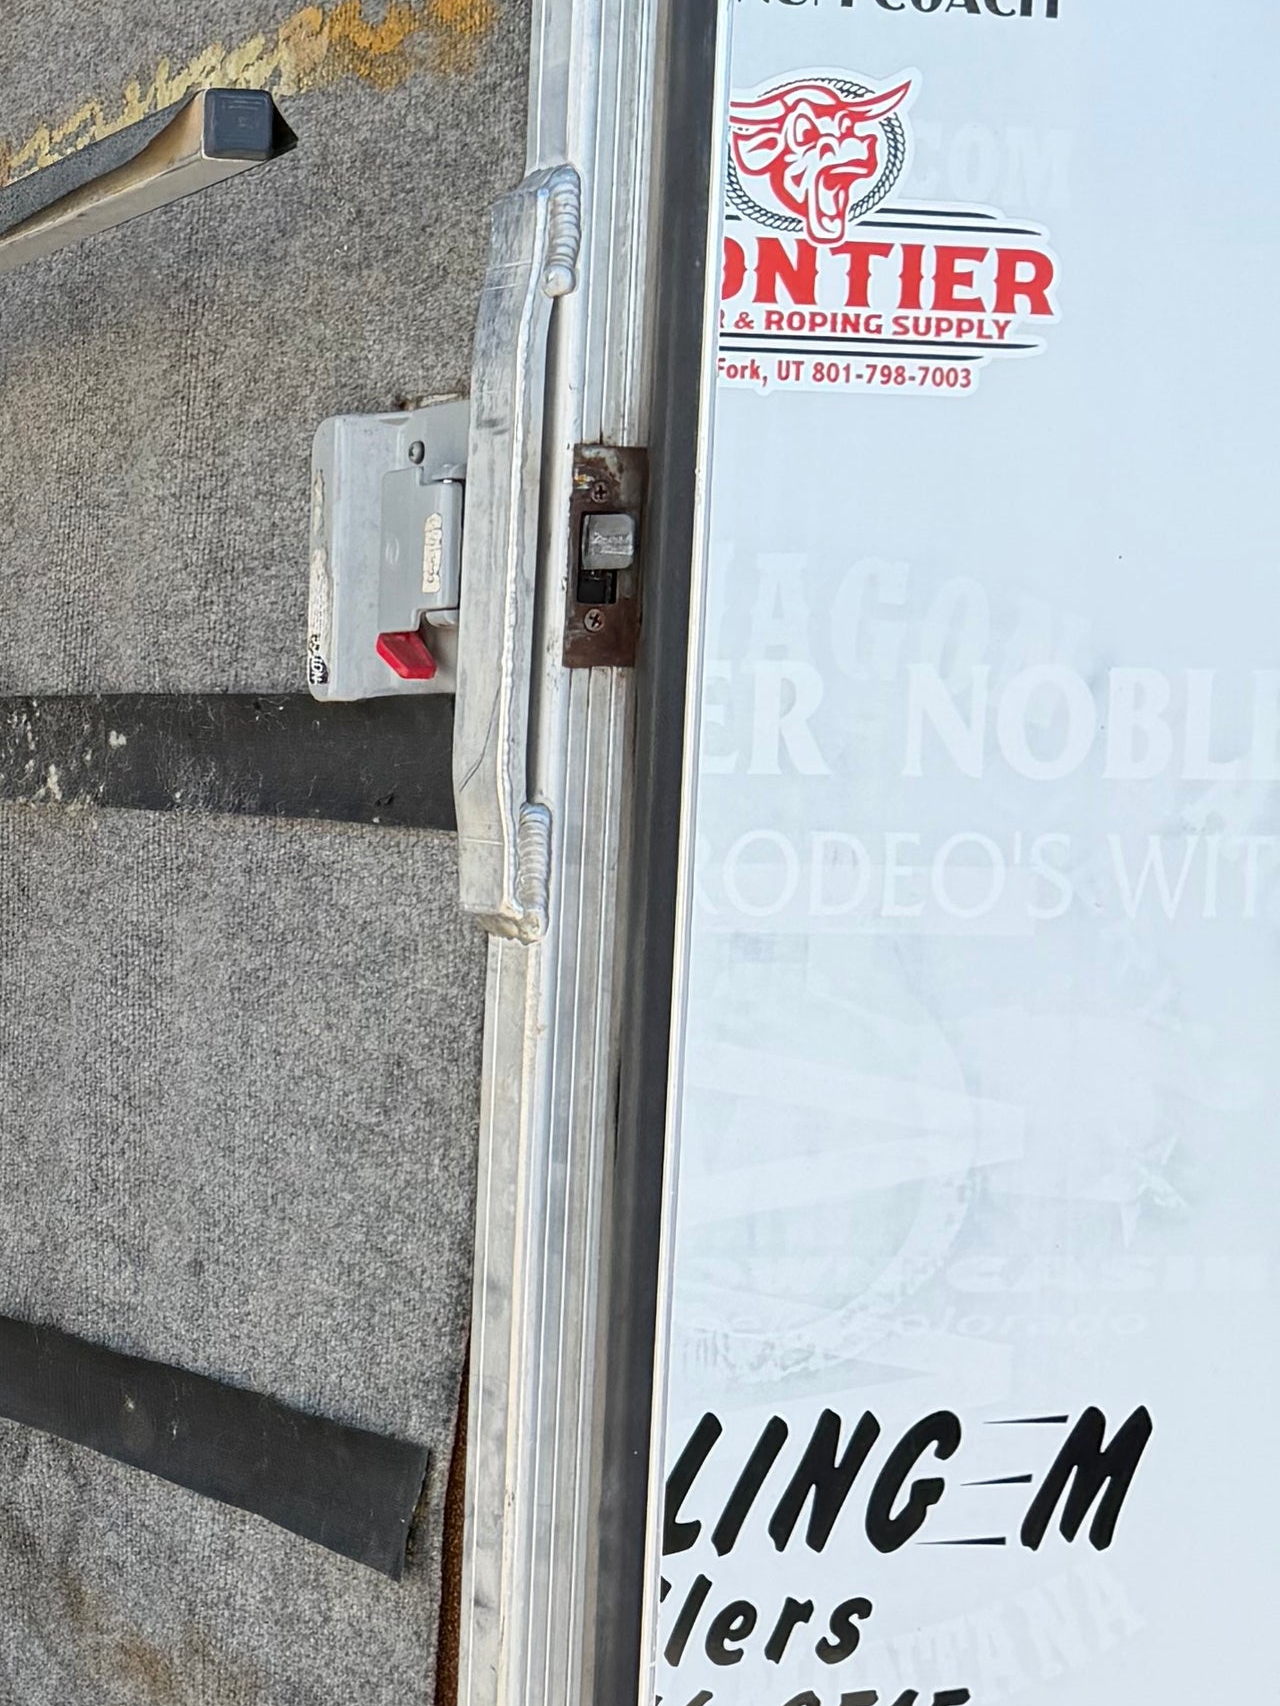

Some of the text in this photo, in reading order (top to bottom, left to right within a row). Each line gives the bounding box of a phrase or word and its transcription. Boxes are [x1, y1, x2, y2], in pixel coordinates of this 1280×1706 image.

[734, 311, 754, 330] &
[762, 310, 883, 336] ROPING
[892, 316, 1012, 340] SUPPLY
[777, 360, 805, 381] UT
[812, 362, 972, 388] 801-798-7003
[661, 1573, 873, 1668] lers
